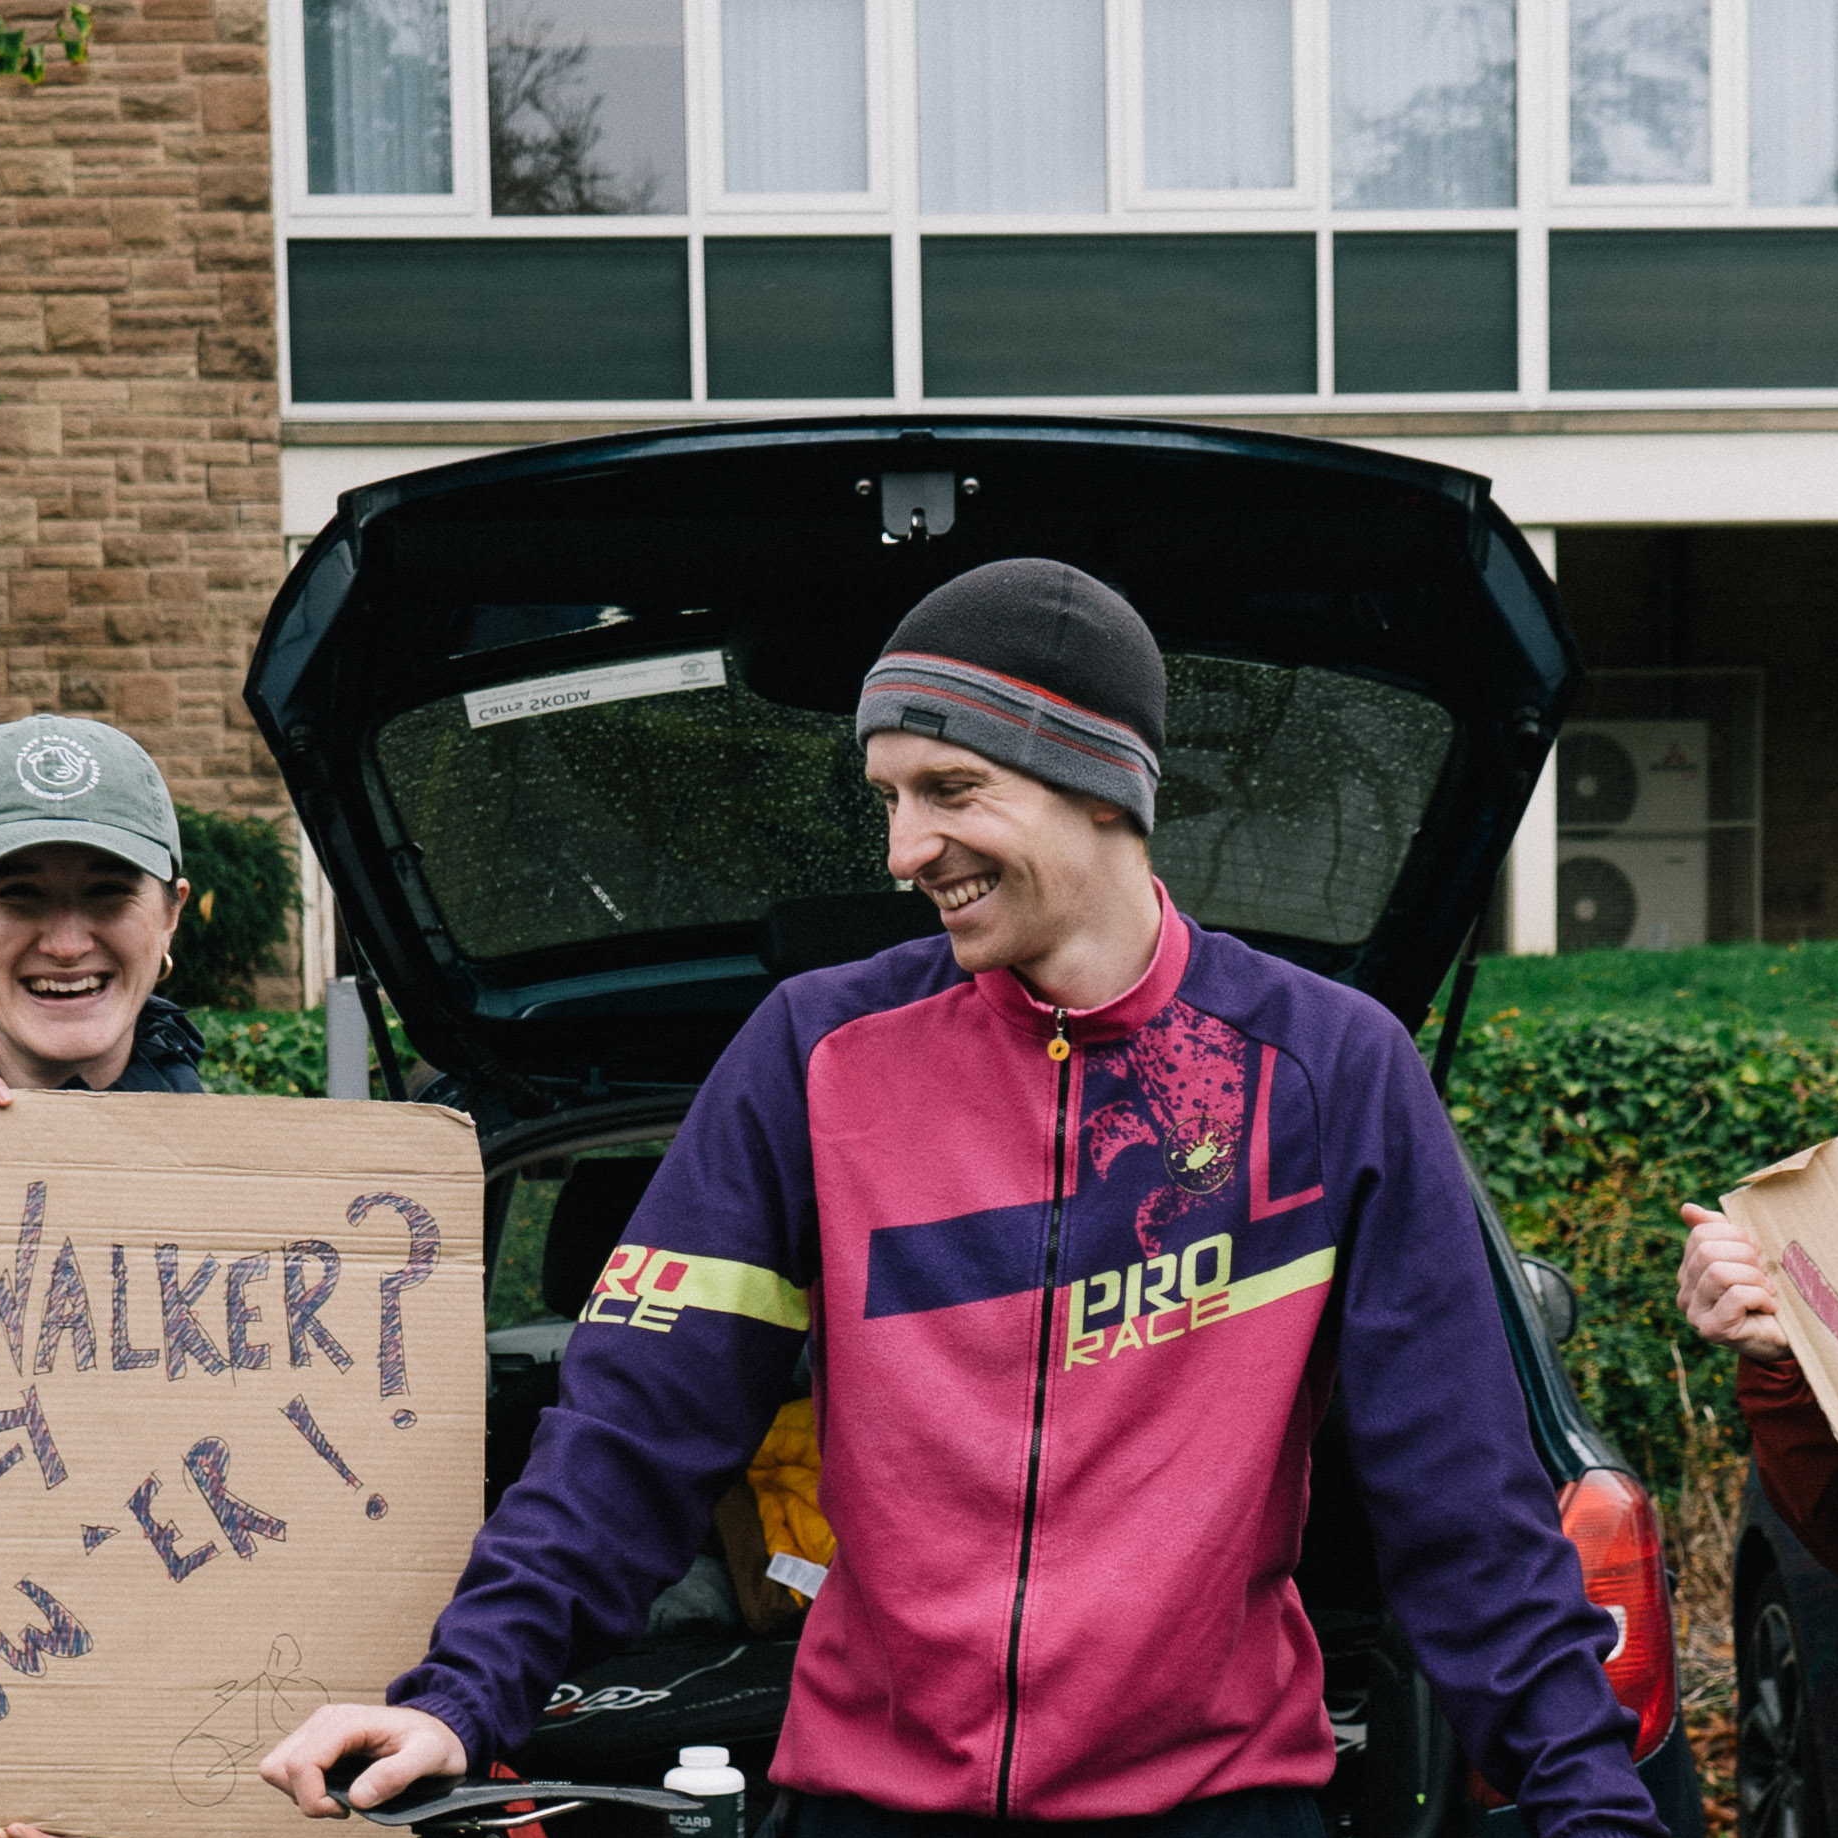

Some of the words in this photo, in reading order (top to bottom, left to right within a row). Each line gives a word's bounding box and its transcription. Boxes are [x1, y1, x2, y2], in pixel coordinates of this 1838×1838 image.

[591, 1244, 694, 1308] RO
[1069, 1232, 1233, 1335] PRO
[1063, 1292, 1235, 1372] RACE
